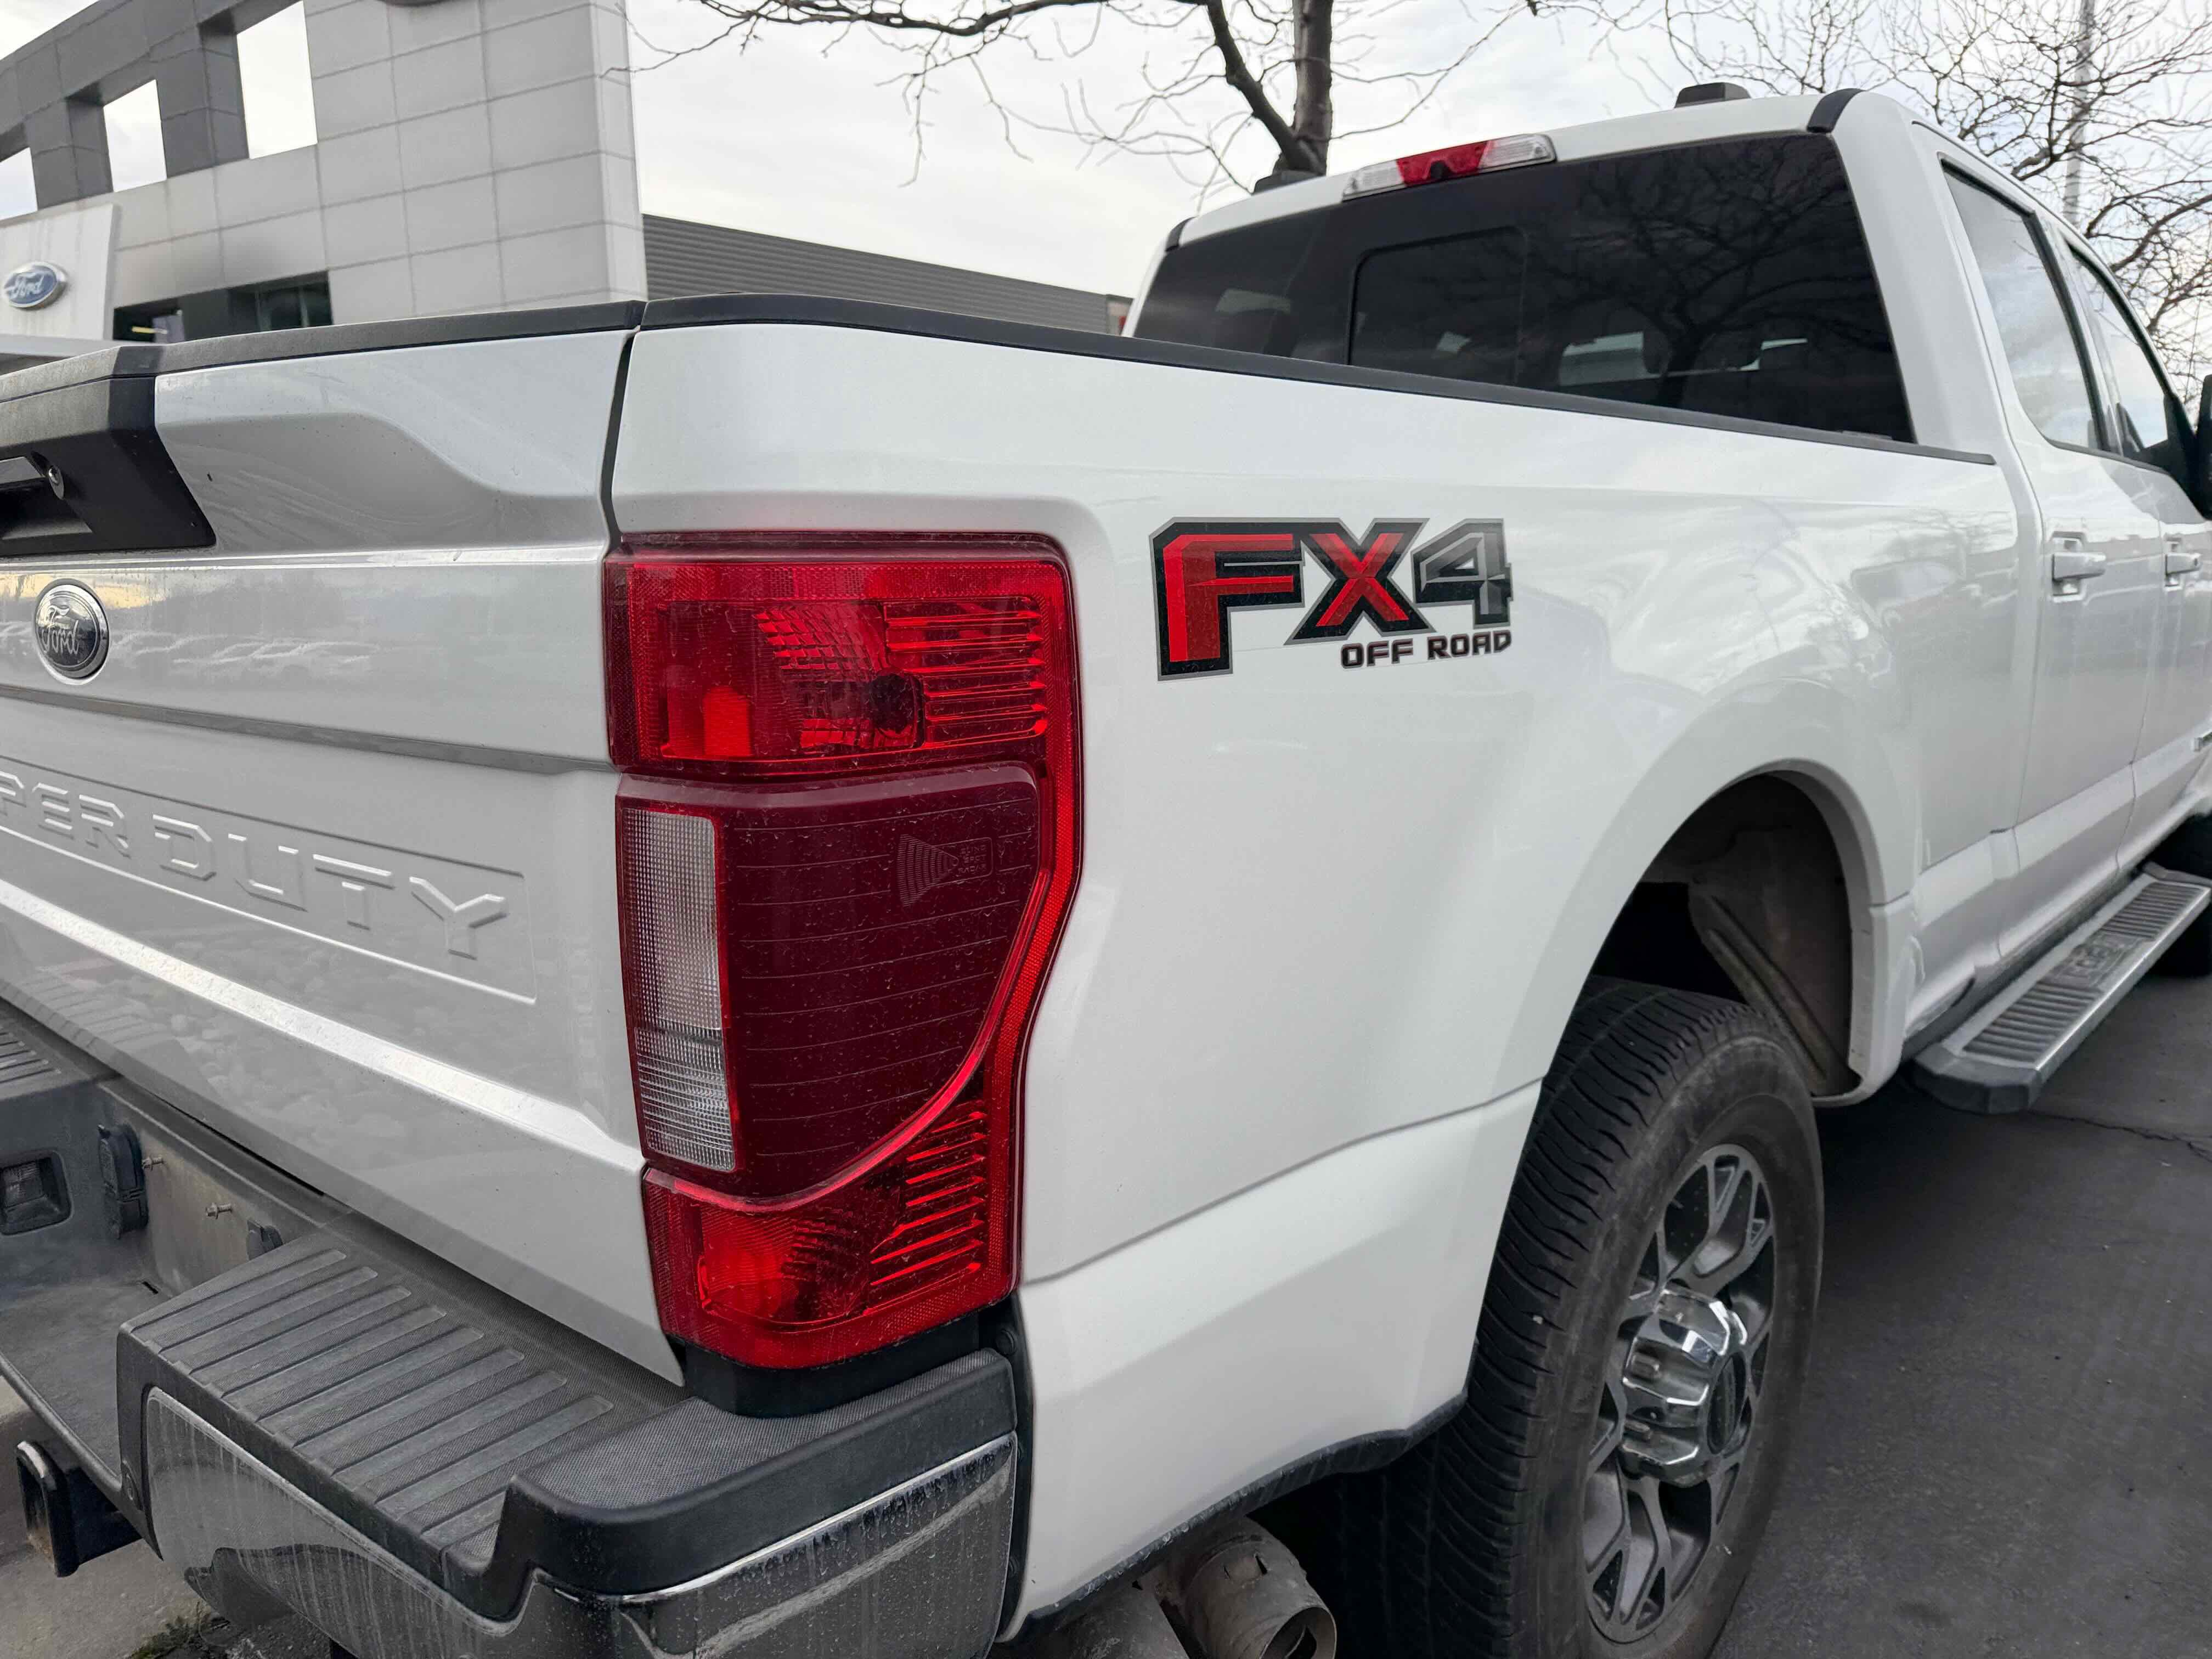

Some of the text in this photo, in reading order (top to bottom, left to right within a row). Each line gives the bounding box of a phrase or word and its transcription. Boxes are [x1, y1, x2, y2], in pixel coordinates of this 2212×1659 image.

[41, 605, 80, 654] Ford
[1149, 517, 1513, 681] FX4
[1340, 629, 1512, 669] OFF ROAD
[153, 814, 507, 961] DUTY
